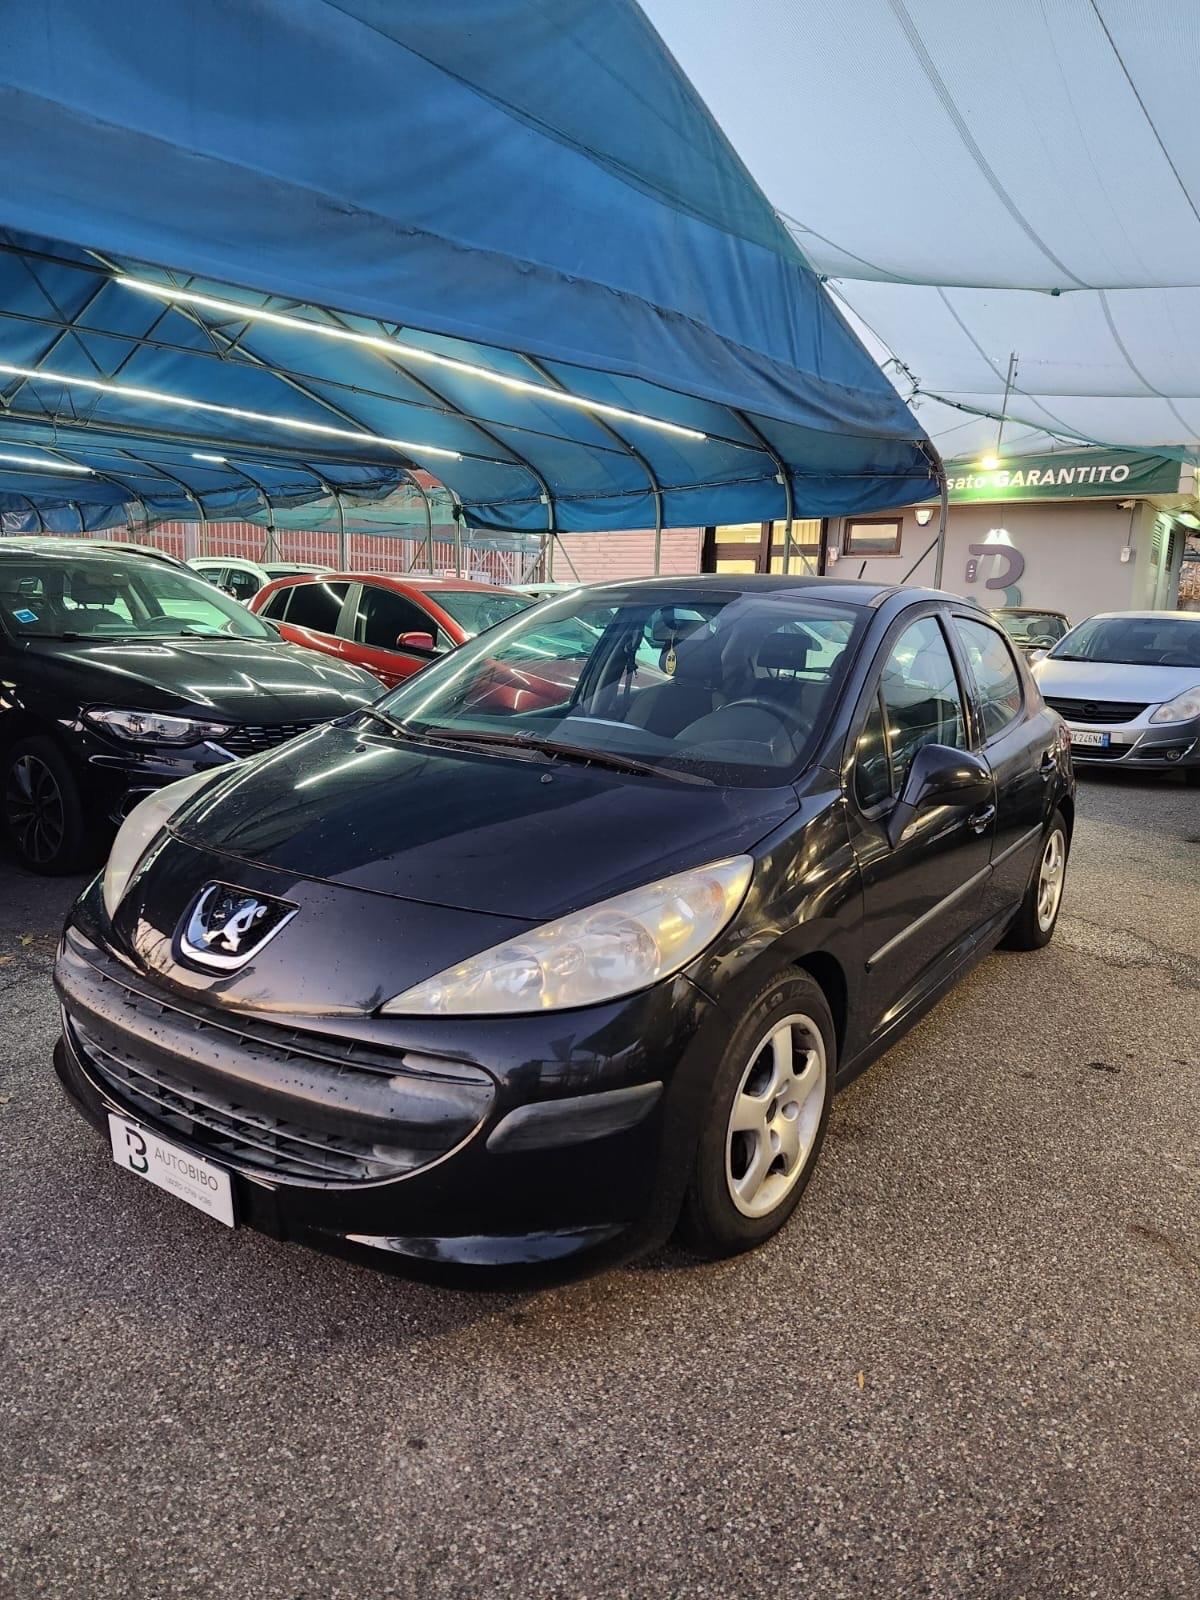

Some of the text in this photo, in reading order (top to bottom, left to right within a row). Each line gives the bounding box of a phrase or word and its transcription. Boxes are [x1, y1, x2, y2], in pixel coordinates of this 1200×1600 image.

[946, 464, 1130, 490] sato GARANTITO
[154, 1147, 219, 1191] AUTOBIBO
